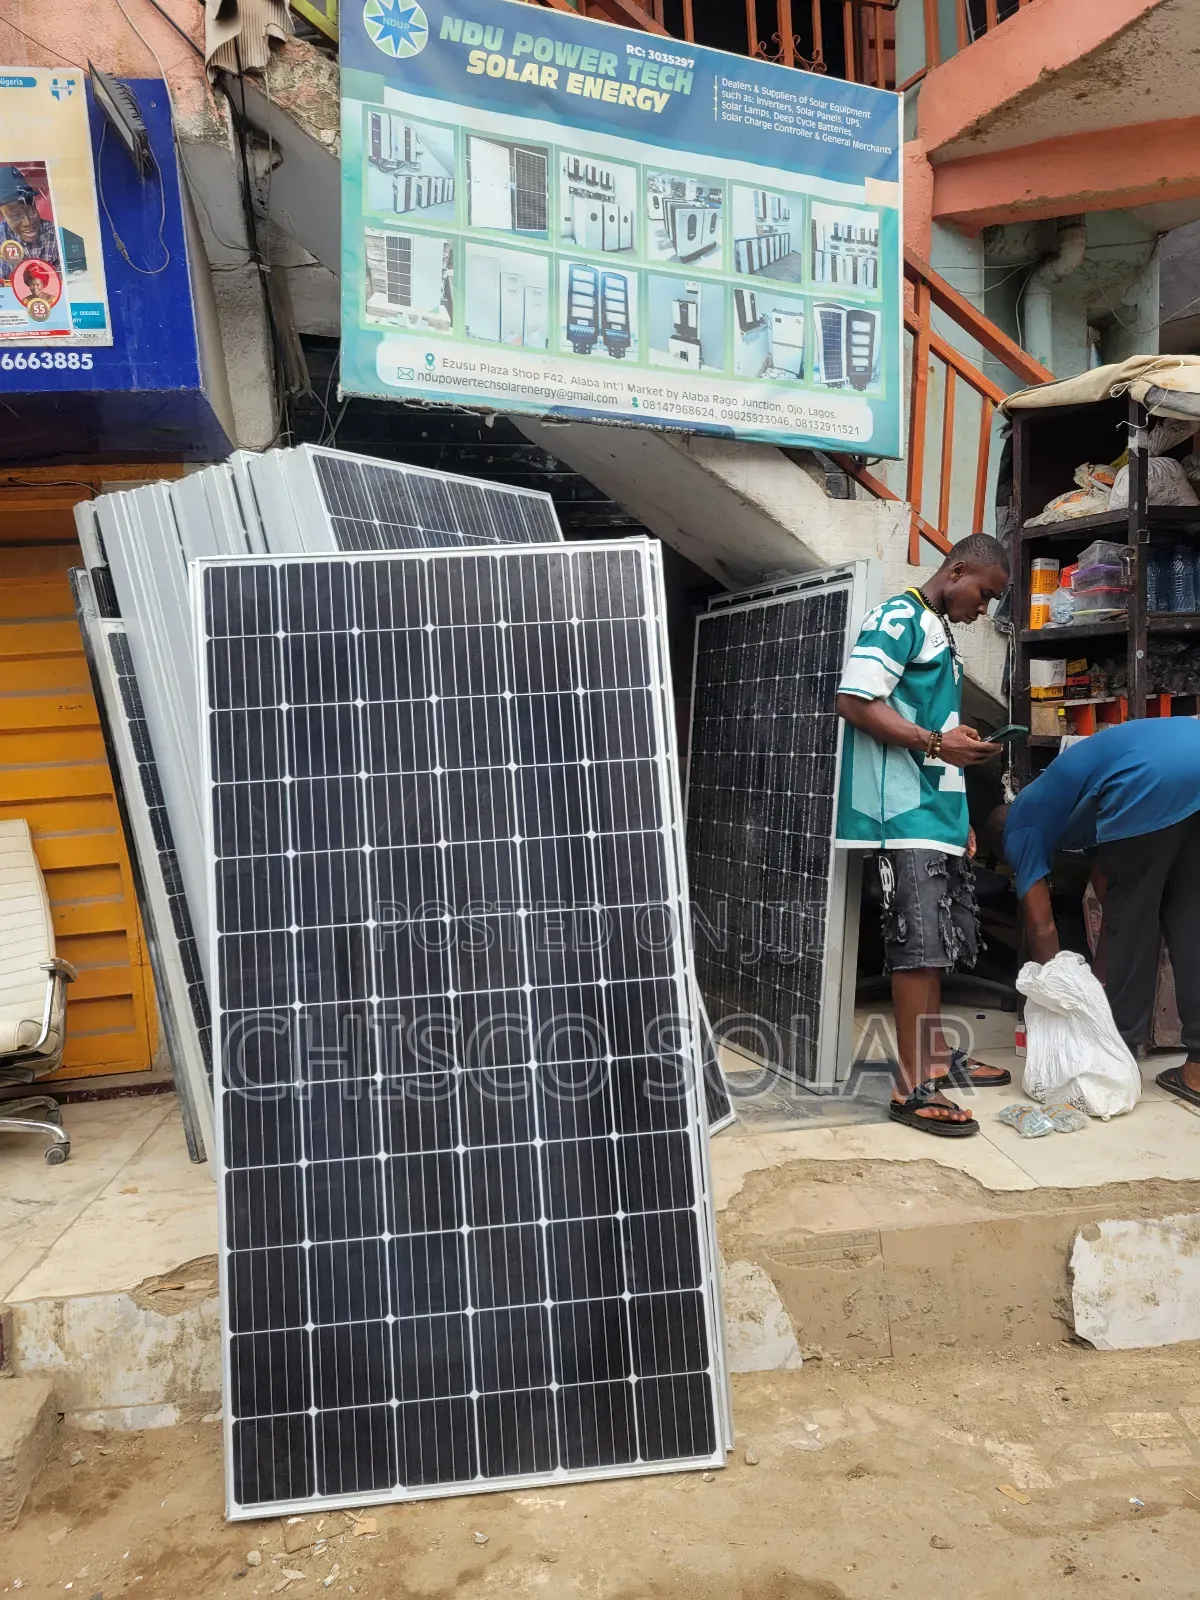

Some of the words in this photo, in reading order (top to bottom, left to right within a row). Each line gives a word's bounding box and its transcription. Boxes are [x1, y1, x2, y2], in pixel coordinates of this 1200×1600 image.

[382, 16, 410, 32] NDUP
[440, 16, 505, 51] NDU
[512, 32, 618, 78] POWER
[627, 58, 694, 96] TECH
[626, 44, 646, 58] RC:
[648, 49, 695, 69] 3035297
[466, 50, 559, 90] SOLAR
[566, 72, 671, 114] ENERGY
[721, 77, 752, 92] Dealers
[753, 85, 760, 94] &
[761, 86, 797, 103] Suppliers
[798, 96, 809, 105] of
[809, 97, 829, 110] Solar
[829, 102, 872, 119] Equipment
[721, 90, 742, 101] such
[743, 94, 755, 104] as:
[756, 96, 794, 113] Inverters,
[796, 105, 816, 117] Solar
[817, 110, 844, 124] Panels,
[845, 116, 862, 129] UPS,
[721, 100, 743, 112] Solar
[744, 104, 772, 120] Lamps,
[773, 111, 795, 125] Deep
[796, 116, 817, 129] Cycle
[818, 121, 854, 138] Batteries,
[721, 111, 743, 123] Solar
[744, 115, 773, 130] Charge
[773, 122, 813, 138] Controller
[814, 131, 821, 140] &
[822, 133, 851, 147] General
[852, 139, 893, 155] Merchants
[33, 304, 46, 314] 55
[1, 352, 94, 370] 6663885
[417, 371, 618, 405] ndupowertechsolarenergy@gmail.com
[642, 399, 718, 419] 08147968624,
[720, 409, 793, 428] 09025923046,
[795, 418, 860, 436] 08132911521
[442, 357, 476, 372] Ezusu
[480, 363, 509, 376] Plaza
[512, 367, 540, 381] Shop
[570, 376, 600, 388] Alaba
[603, 380, 624, 391] Int'l
[627, 383, 664, 396] Market
[666, 388, 679, 400] by
[681, 391, 709, 403] Alaba
[712, 394, 738, 407] Rago
[740, 398, 784, 413] Junction,
